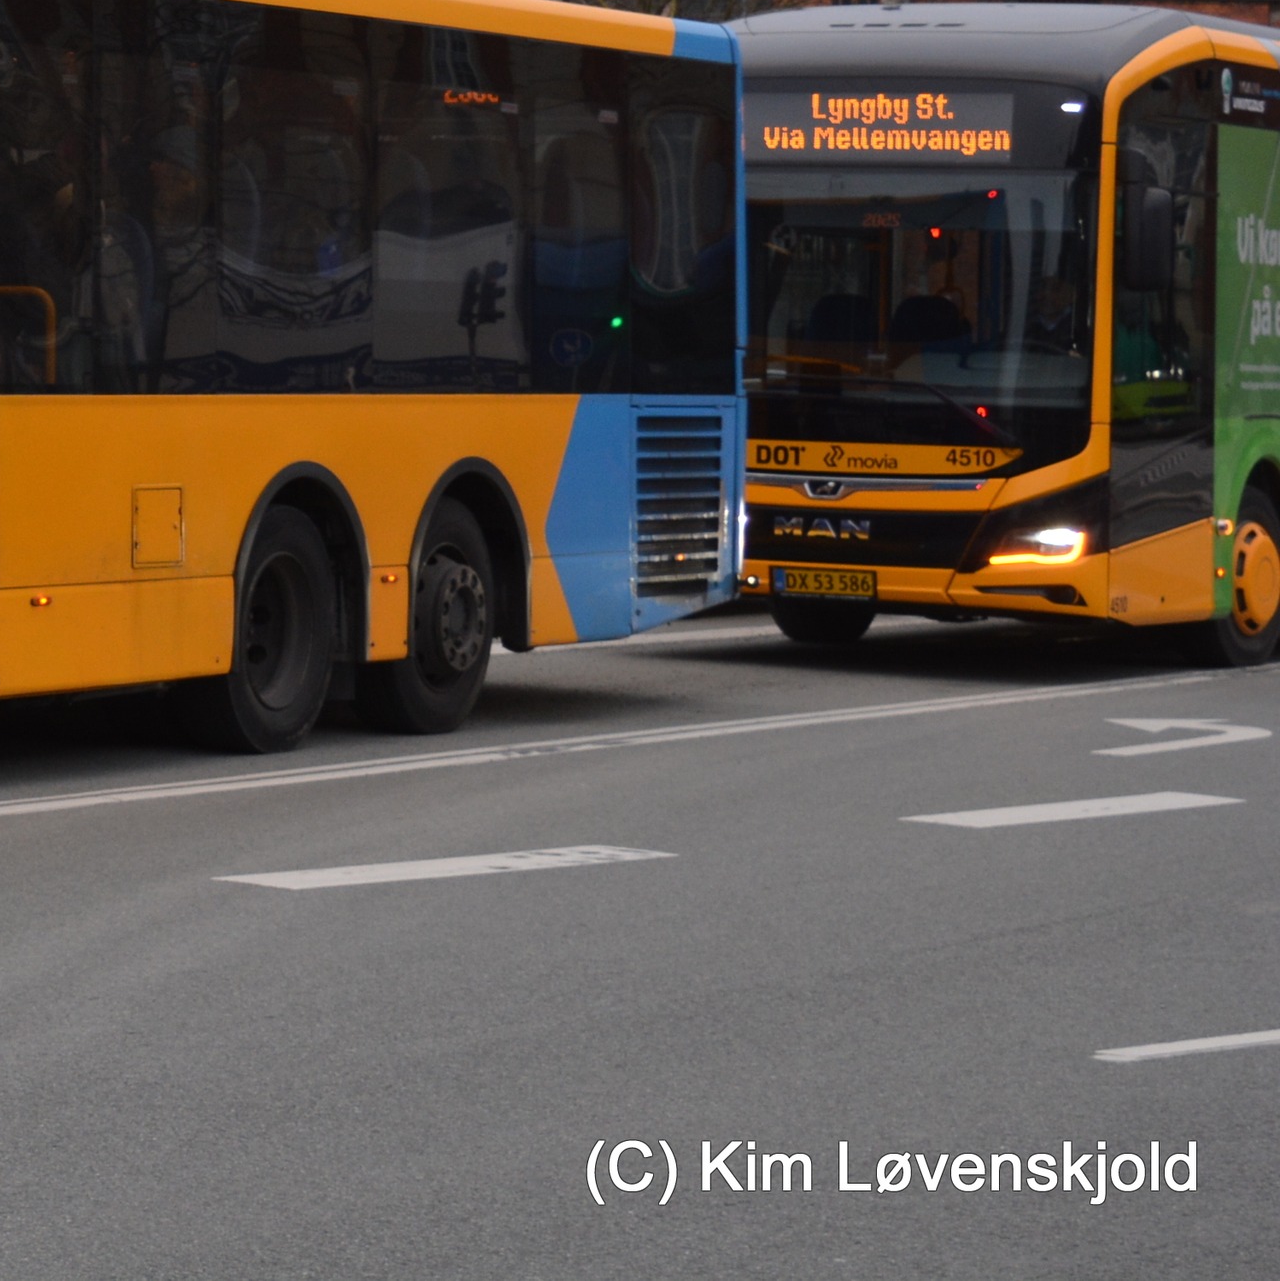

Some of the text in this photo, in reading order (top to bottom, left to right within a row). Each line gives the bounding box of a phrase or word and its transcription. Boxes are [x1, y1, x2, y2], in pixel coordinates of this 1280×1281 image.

[811, 93, 954, 124] Lyngby St.
[763, 127, 1011, 155] Via Mellemvangen
[1237, 214, 1255, 264] Vi
[1251, 285, 1272, 345] på
[756, 445, 898, 469] DOT movia
[945, 450, 995, 467] 4510
[774, 515, 870, 539] MAN
[786, 571, 871, 593] DX 53 586
